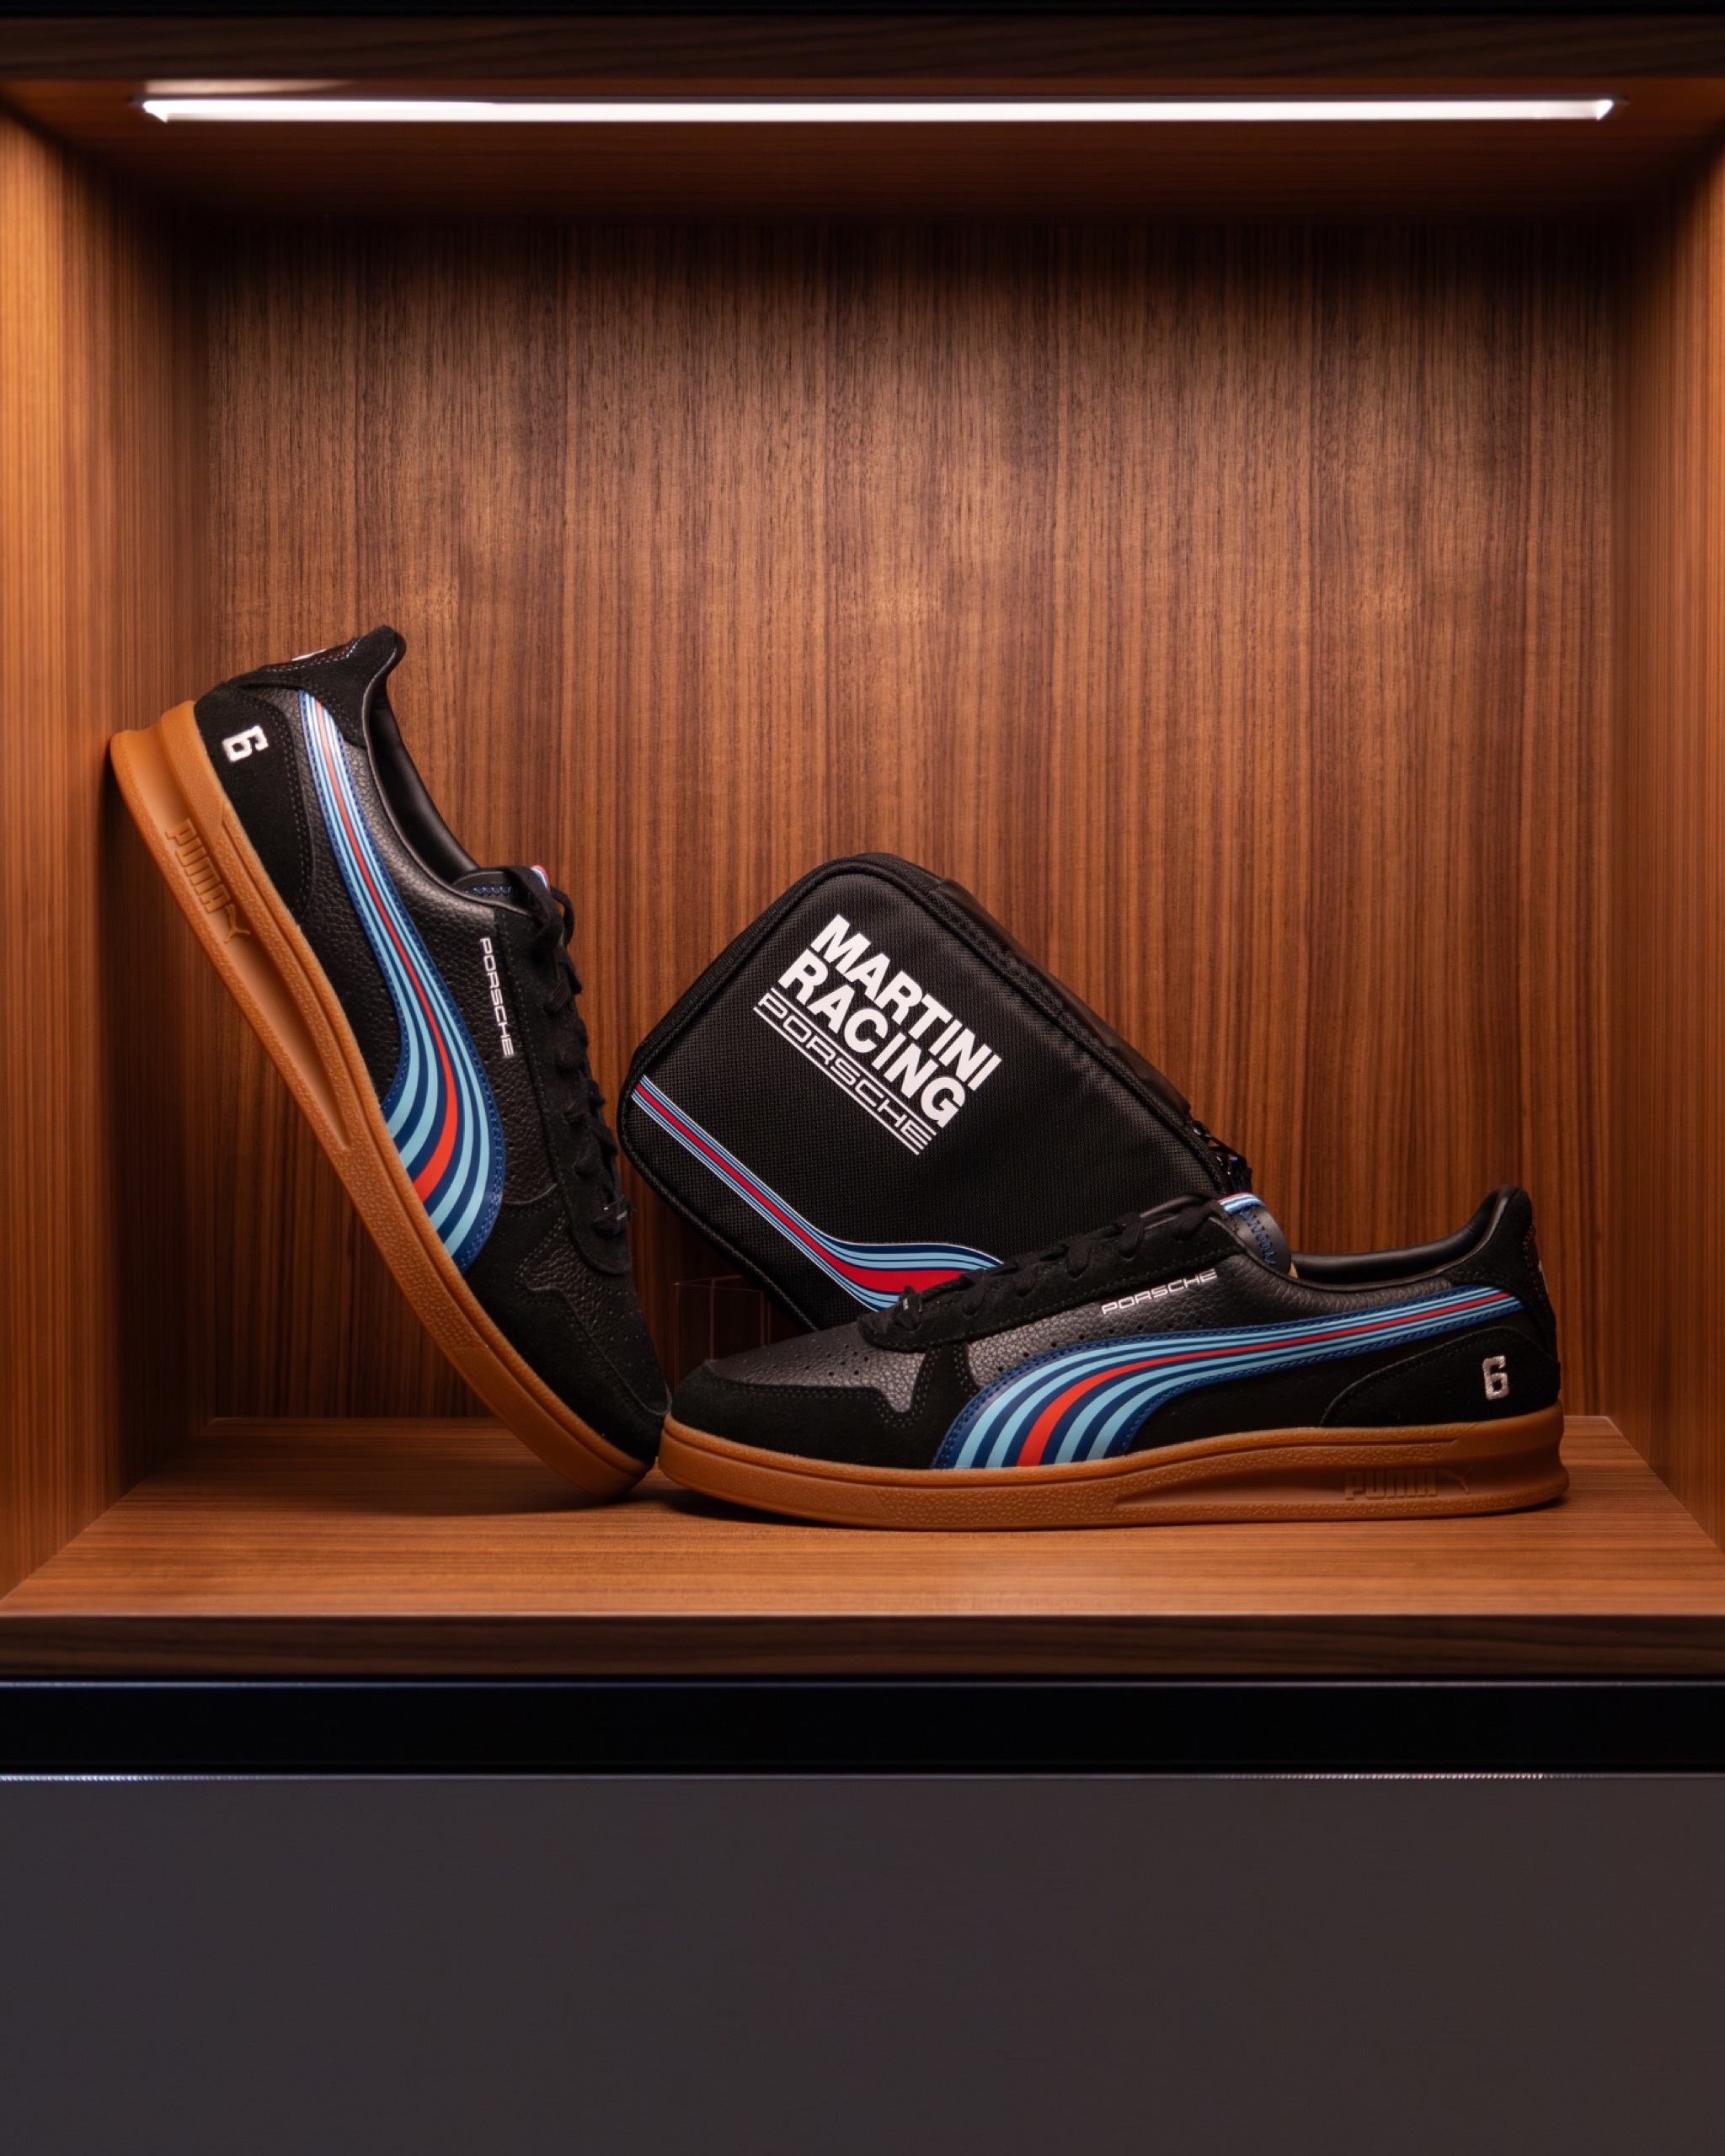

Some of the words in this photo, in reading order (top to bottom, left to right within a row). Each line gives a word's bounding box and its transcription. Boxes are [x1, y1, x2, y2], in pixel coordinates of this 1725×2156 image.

[222, 725, 269, 763] 6
[165, 819, 231, 914] PUMA
[480, 937, 515, 1057] PORSCHE
[777, 948, 966, 1129] RACING
[810, 914, 1002, 1091] MARTINI
[758, 992, 932, 1150] PORSCHE
[1101, 1267, 1218, 1315] PORSCHE
[1482, 1355, 1510, 1401] 6
[1345, 1468, 1437, 1501] PUMA
